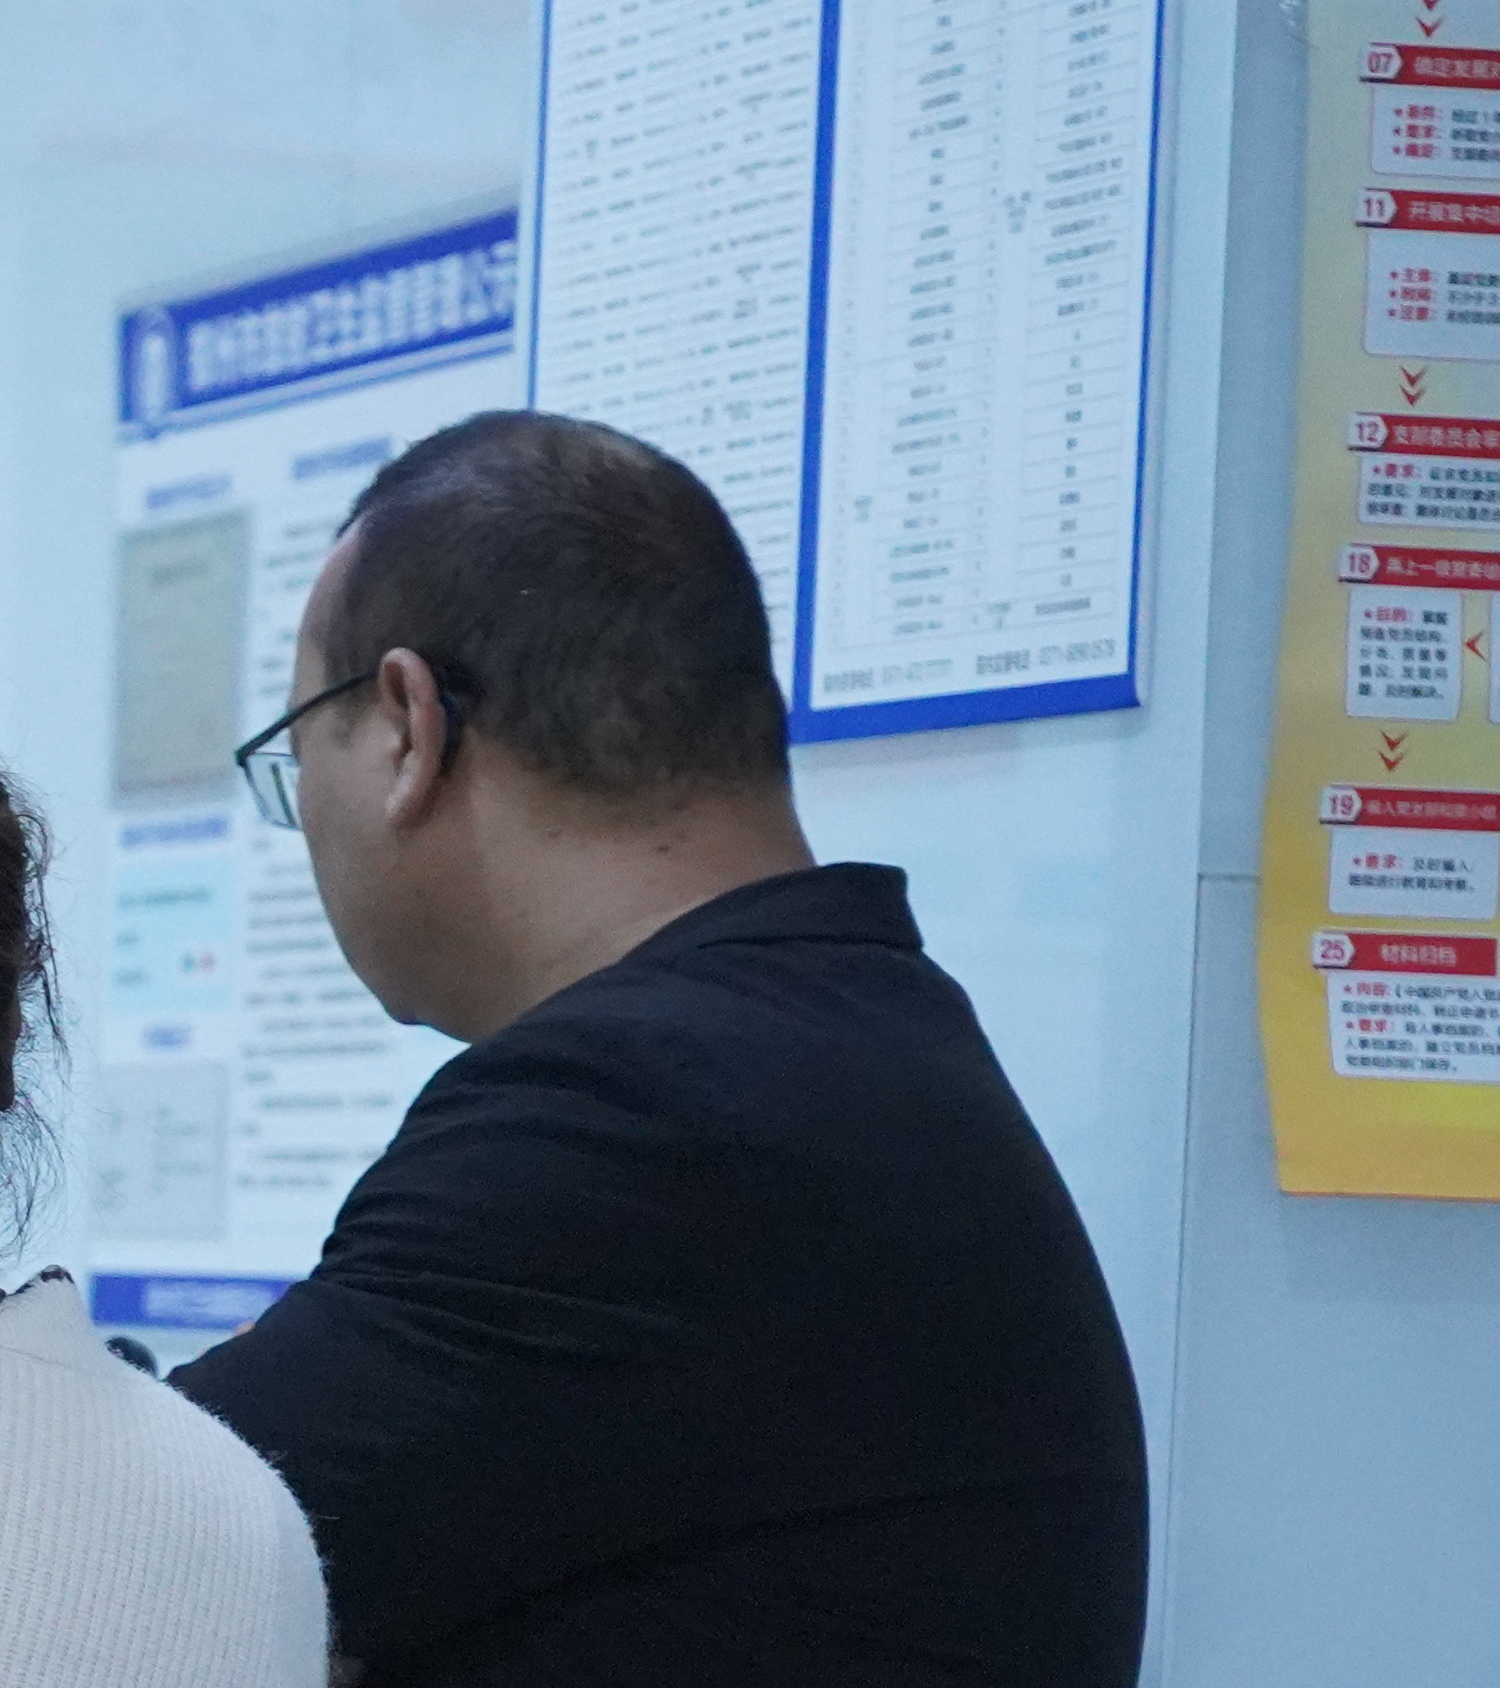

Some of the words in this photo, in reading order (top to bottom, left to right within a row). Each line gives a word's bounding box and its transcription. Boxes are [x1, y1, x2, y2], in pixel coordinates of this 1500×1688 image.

[1367, 52, 1393, 73] 07
[1363, 197, 1386, 218] 11
[1356, 421, 1380, 443] 12
[1347, 552, 1371, 574] 18
[1329, 794, 1354, 816] 19
[1320, 938, 1345, 960] 25
